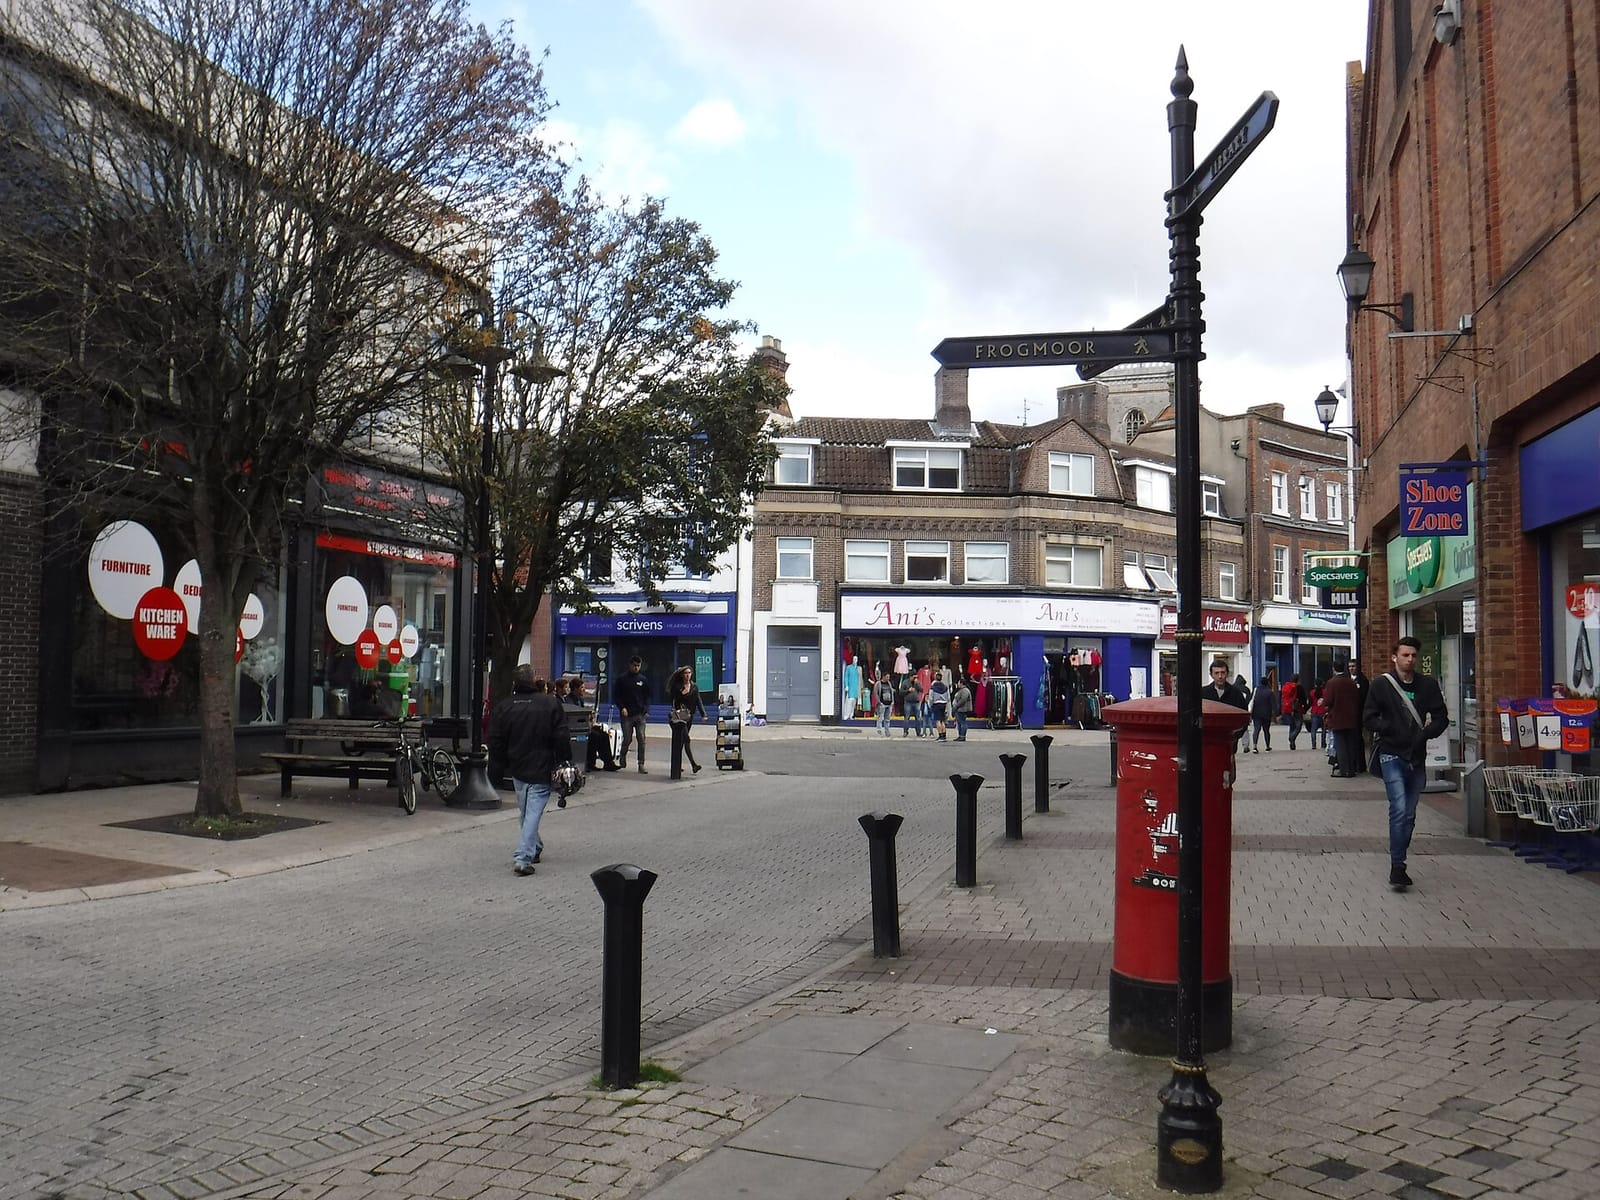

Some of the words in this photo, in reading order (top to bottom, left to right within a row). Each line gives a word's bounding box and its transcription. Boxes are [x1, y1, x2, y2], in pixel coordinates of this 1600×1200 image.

[975, 340, 1096, 359] FROGMOOR
[1406, 479, 1462, 503] Shoe
[1407, 506, 1462, 531] Zone
[101, 559, 151, 576] FURNITURE
[1310, 571, 1359, 581] Specsavers
[1331, 592, 1359, 605] HILL
[139, 607, 184, 624] KITCHEN
[865, 600, 936, 626] Ani's
[1035, 602, 1080, 622] Ani's
[146, 625, 177, 639] WARE
[616, 618, 663, 631] scrivens
[1214, 617, 1242, 633] Textiles
[696, 656, 712, 664] £10
[1540, 725, 1561, 737] 4.99
